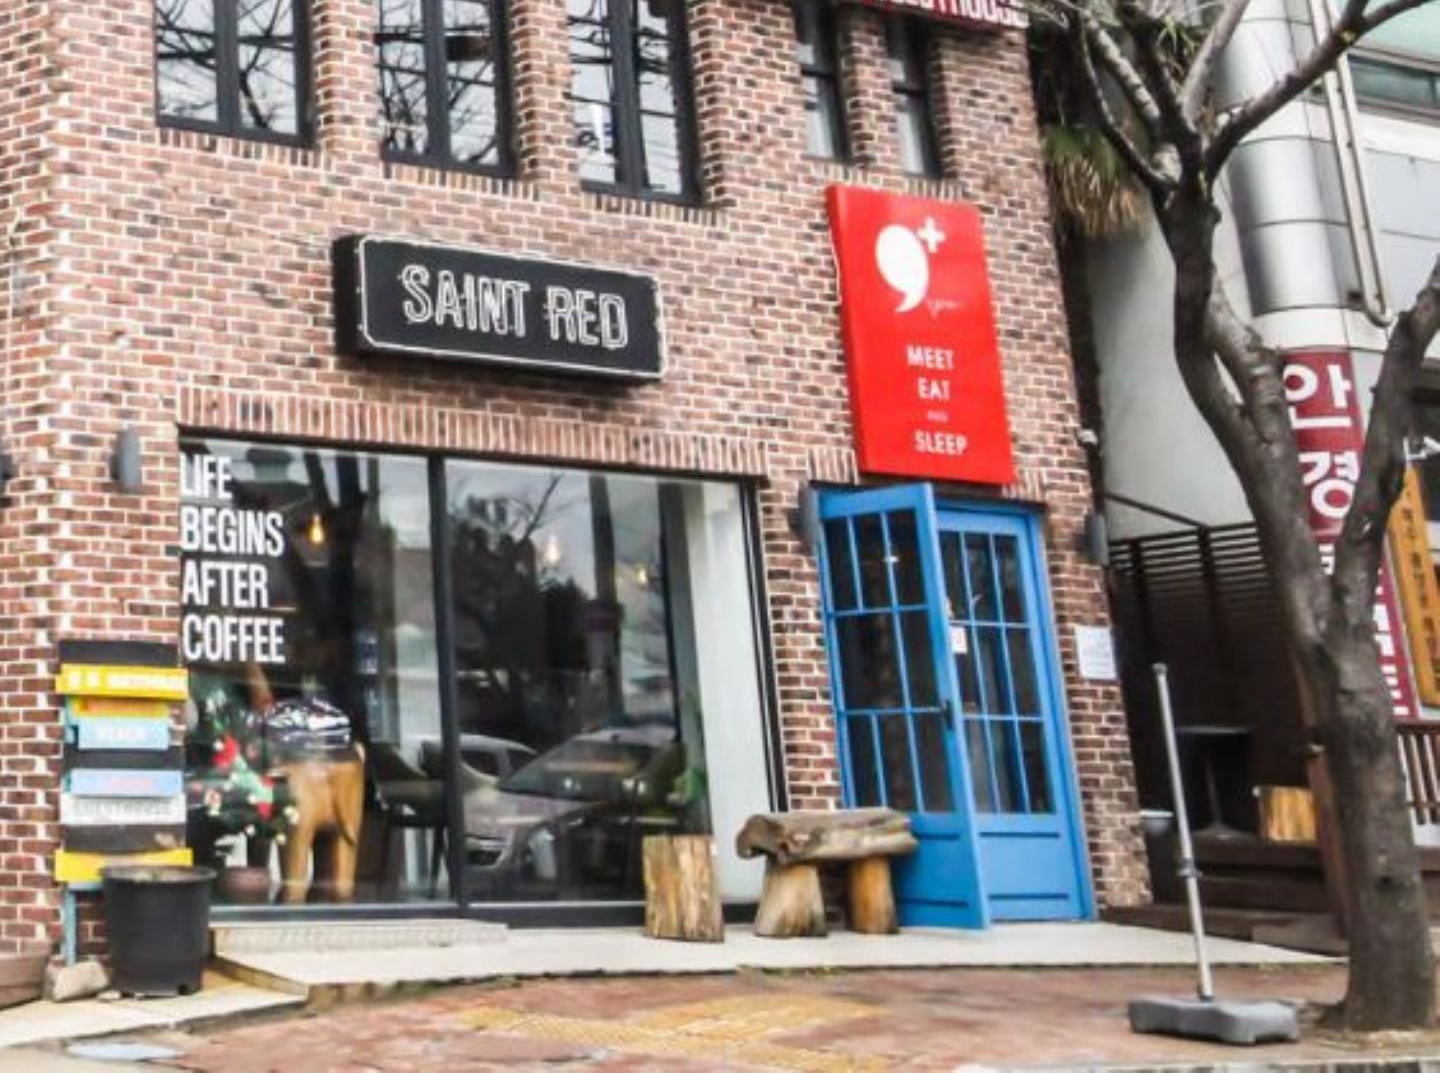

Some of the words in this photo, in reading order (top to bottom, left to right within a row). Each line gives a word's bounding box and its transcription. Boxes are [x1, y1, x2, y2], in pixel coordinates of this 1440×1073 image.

[400, 264, 530, 338] SAINT
[544, 286, 628, 350] RED
[907, 345, 955, 370] MEET
[918, 376, 951, 401] EAT
[915, 431, 967, 456] SLEEP
[1282, 362, 1360, 520] 안경
[179, 452, 233, 500] LIFE
[180, 506, 285, 557] BEGINS
[181, 560, 269, 608] AFTER
[182, 613, 286, 664] COFFEE
